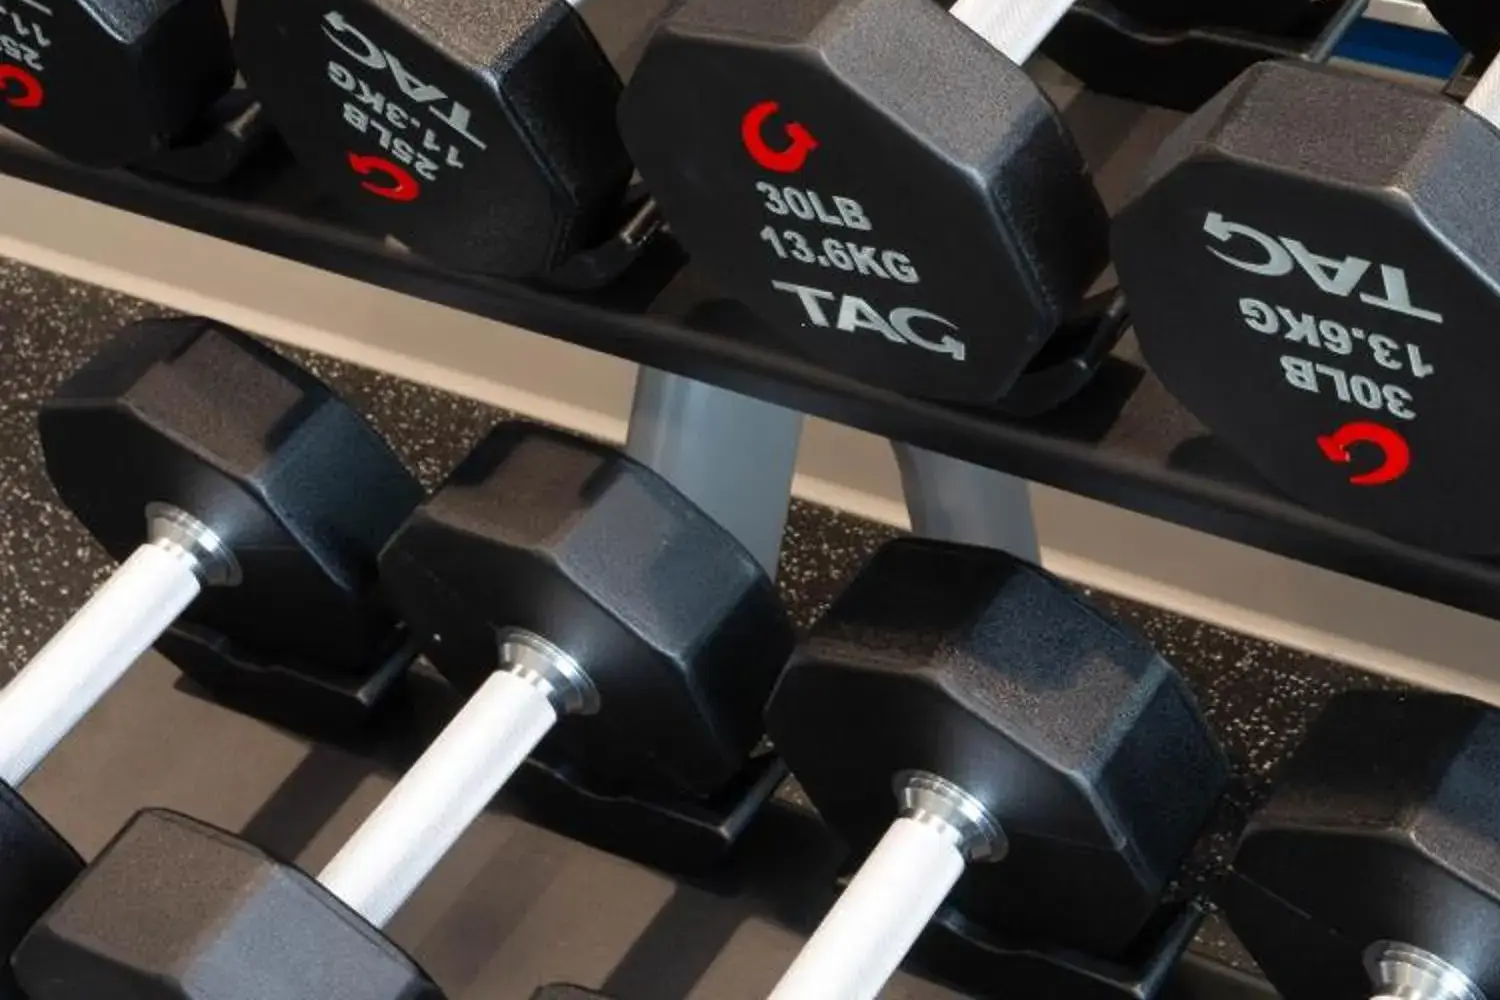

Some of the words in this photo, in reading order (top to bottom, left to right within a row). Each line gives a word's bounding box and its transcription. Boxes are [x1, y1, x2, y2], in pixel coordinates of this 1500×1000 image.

[323, 10, 487, 150] TAG
[328, 61, 464, 169] 11.3KG
[343, 103, 438, 181] 25LB
[756, 181, 872, 232] 30LB
[760, 225, 920, 283] 13.6KG
[1202, 211, 1443, 324] TAG
[772, 279, 968, 361] TAG
[1239, 297, 1434, 378] 13.6KG
[1279, 355, 1416, 420] 30LB
